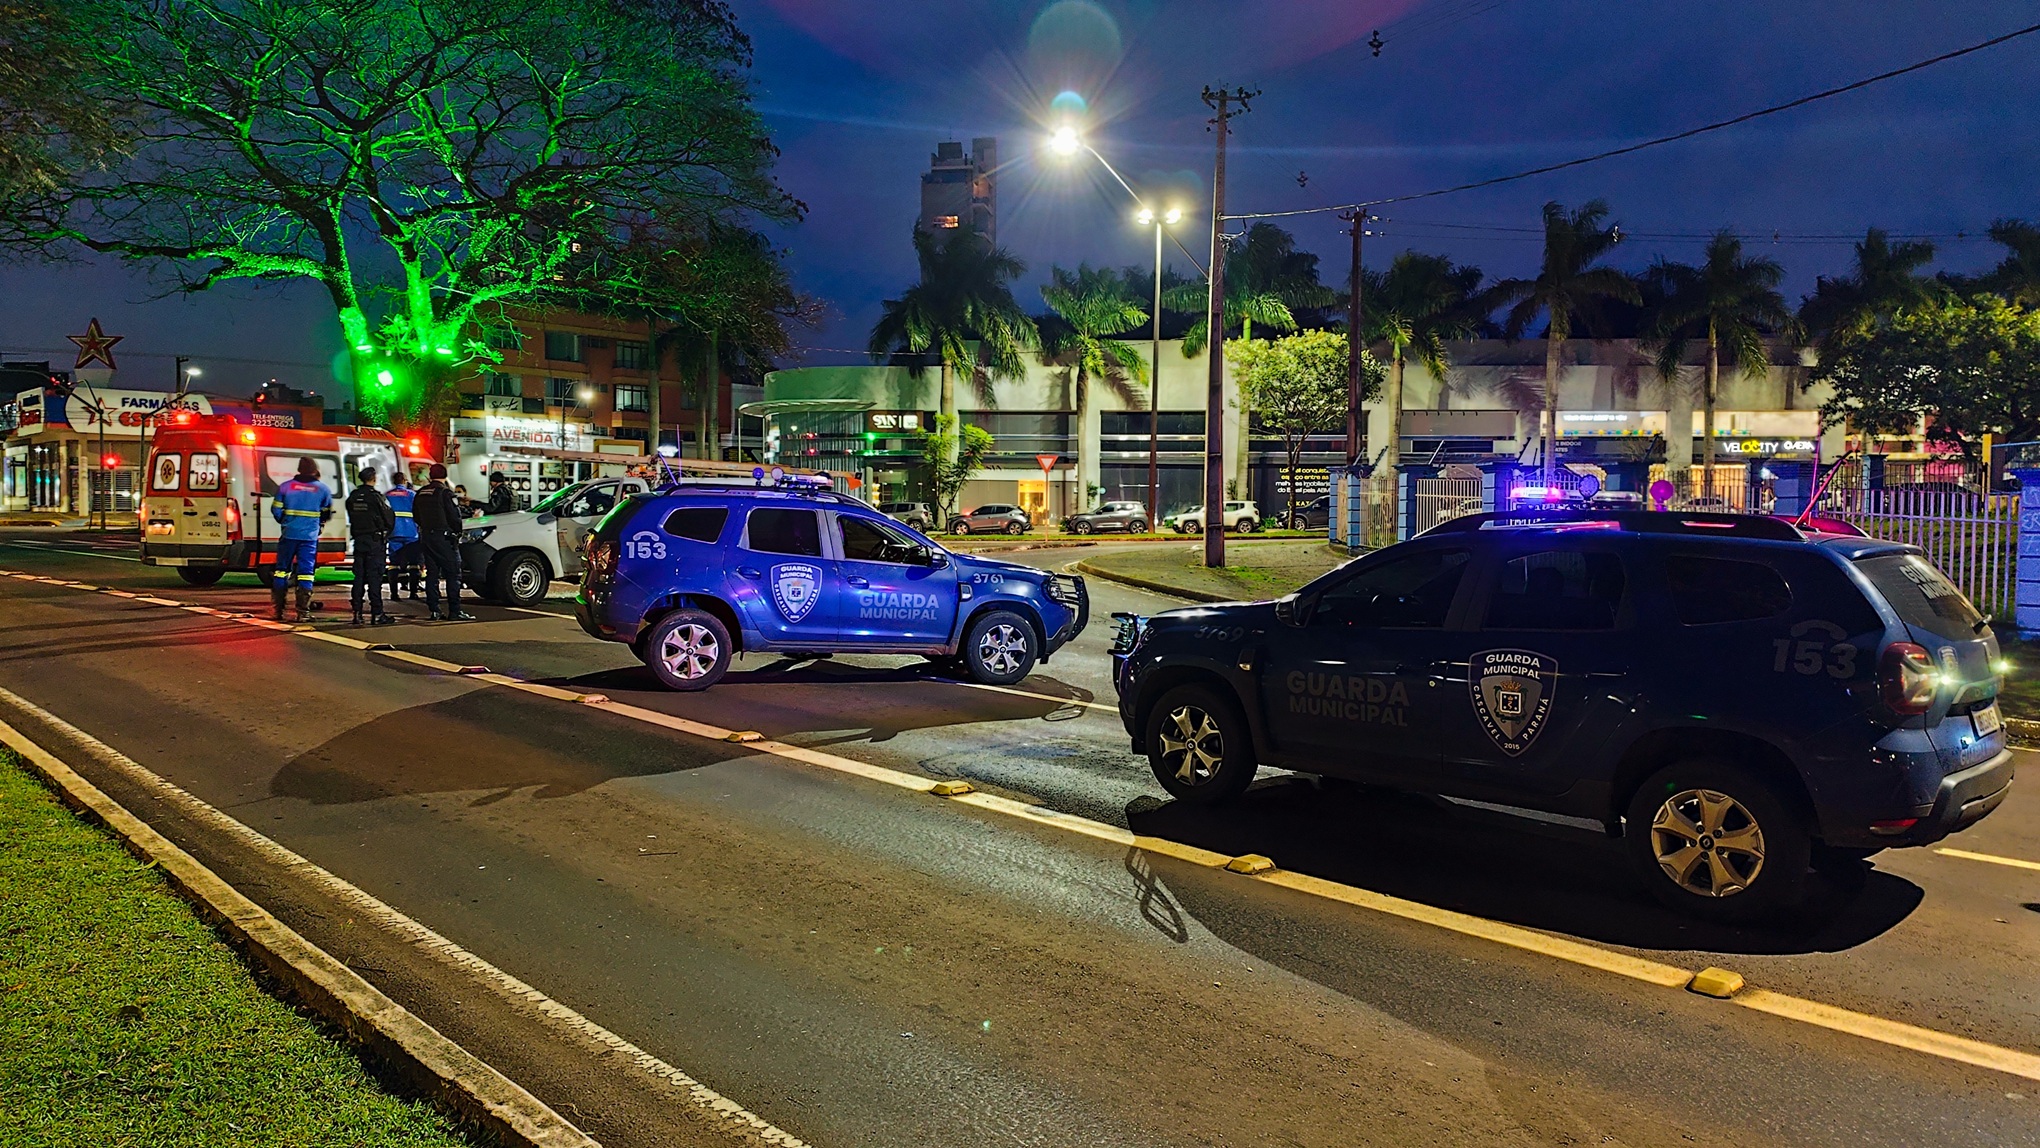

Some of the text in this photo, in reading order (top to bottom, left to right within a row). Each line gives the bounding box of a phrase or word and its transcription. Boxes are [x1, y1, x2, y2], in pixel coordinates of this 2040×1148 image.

[121, 397, 200, 411] FARMÁCIAS
[493, 429, 553, 443] AVENIDA
[194, 472, 215, 486] 192
[626, 541, 667, 559] 153
[780, 565, 813, 573] GUARDA
[780, 572, 814, 580] MUNICIPAL
[973, 573, 1005, 584] 3761
[859, 592, 940, 609] GUARDA
[860, 608, 938, 620] MUNICIPAL
[1193, 624, 1245, 642] 3769
[1485, 653, 1540, 668] GUARDA
[1773, 639, 1858, 679] 153
[1483, 665, 1540, 680] MUNICIPAL
[1286, 670, 1411, 707] GUARDA
[1289, 696, 1408, 727] MUNICIPAL
[1473, 685, 1501, 740] CASCAVEL
[1522, 697, 1550, 740] PARANÁ
[1504, 742, 1520, 750] 2015
